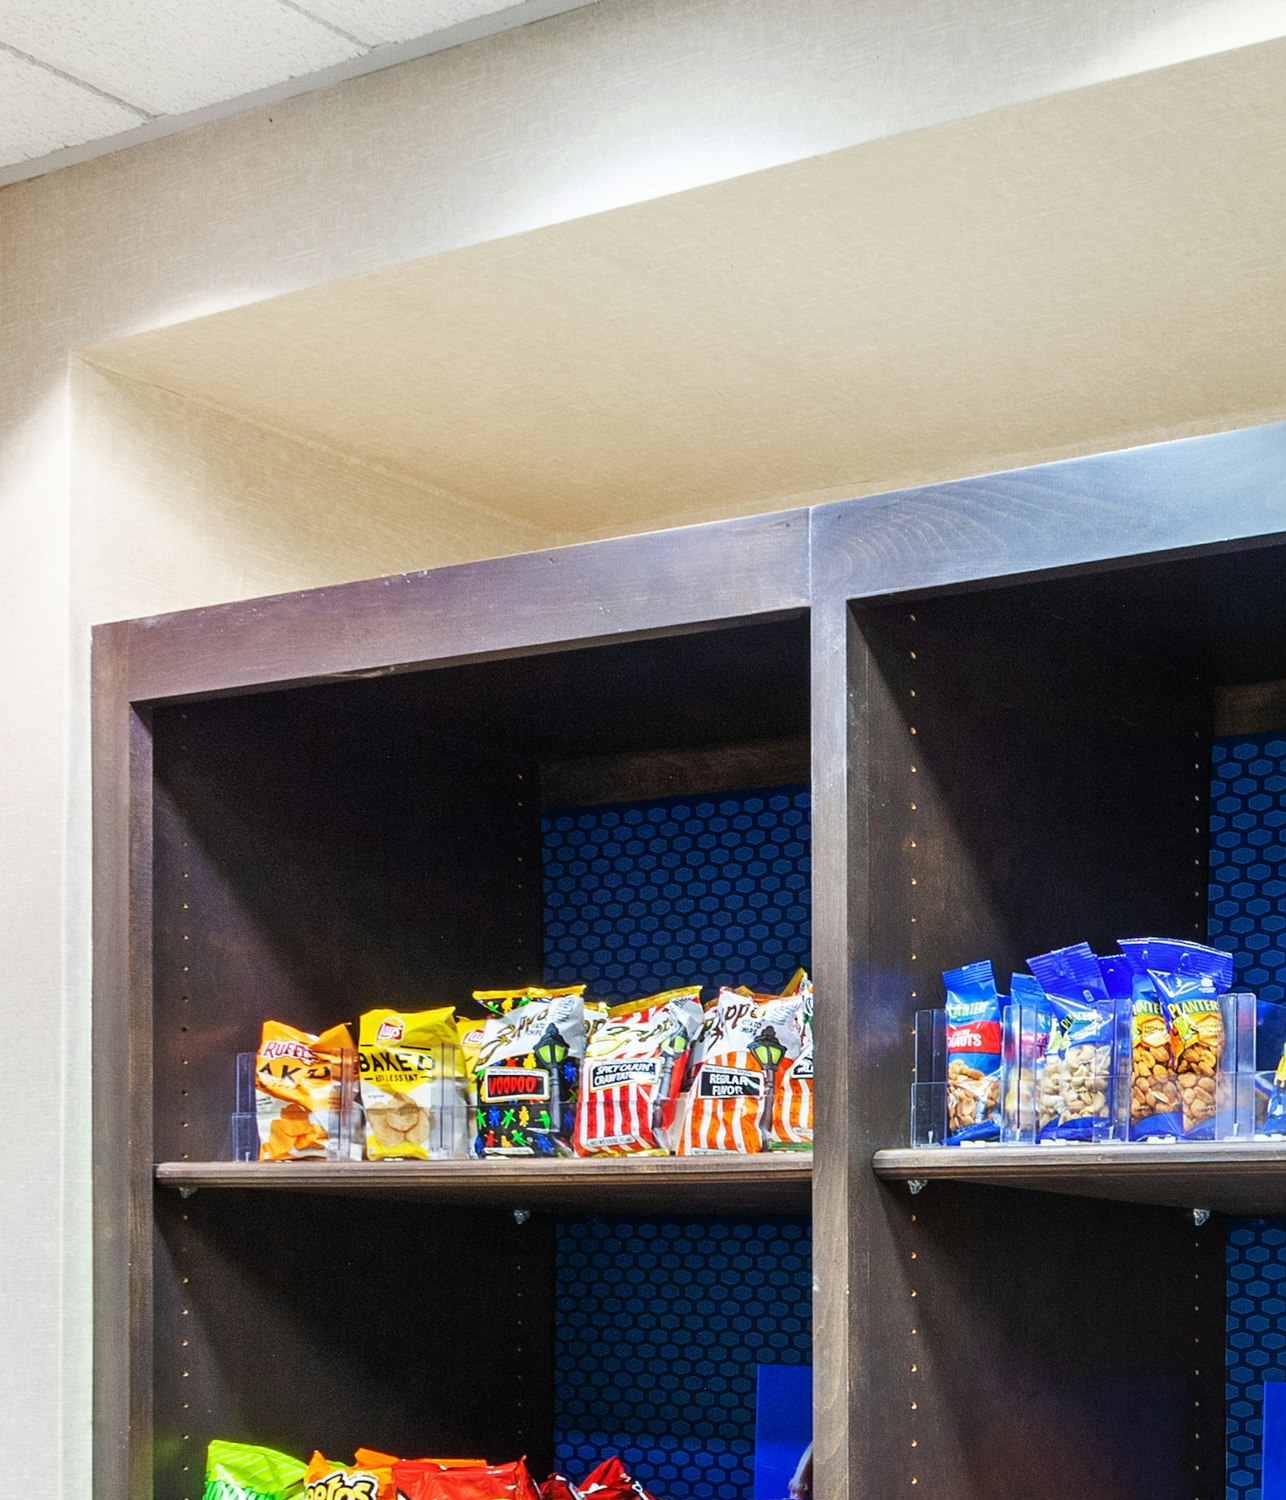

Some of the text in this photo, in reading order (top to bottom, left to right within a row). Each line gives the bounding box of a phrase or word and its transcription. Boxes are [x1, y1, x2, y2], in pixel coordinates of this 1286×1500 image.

[359, 1052, 436, 1073] BAKED
[596, 1063, 620, 1075] SPICY
[405, 1074, 418, 1082] FAT
[709, 1073, 749, 1085] REGULAR
[488, 1076, 538, 1096] VOODOO
